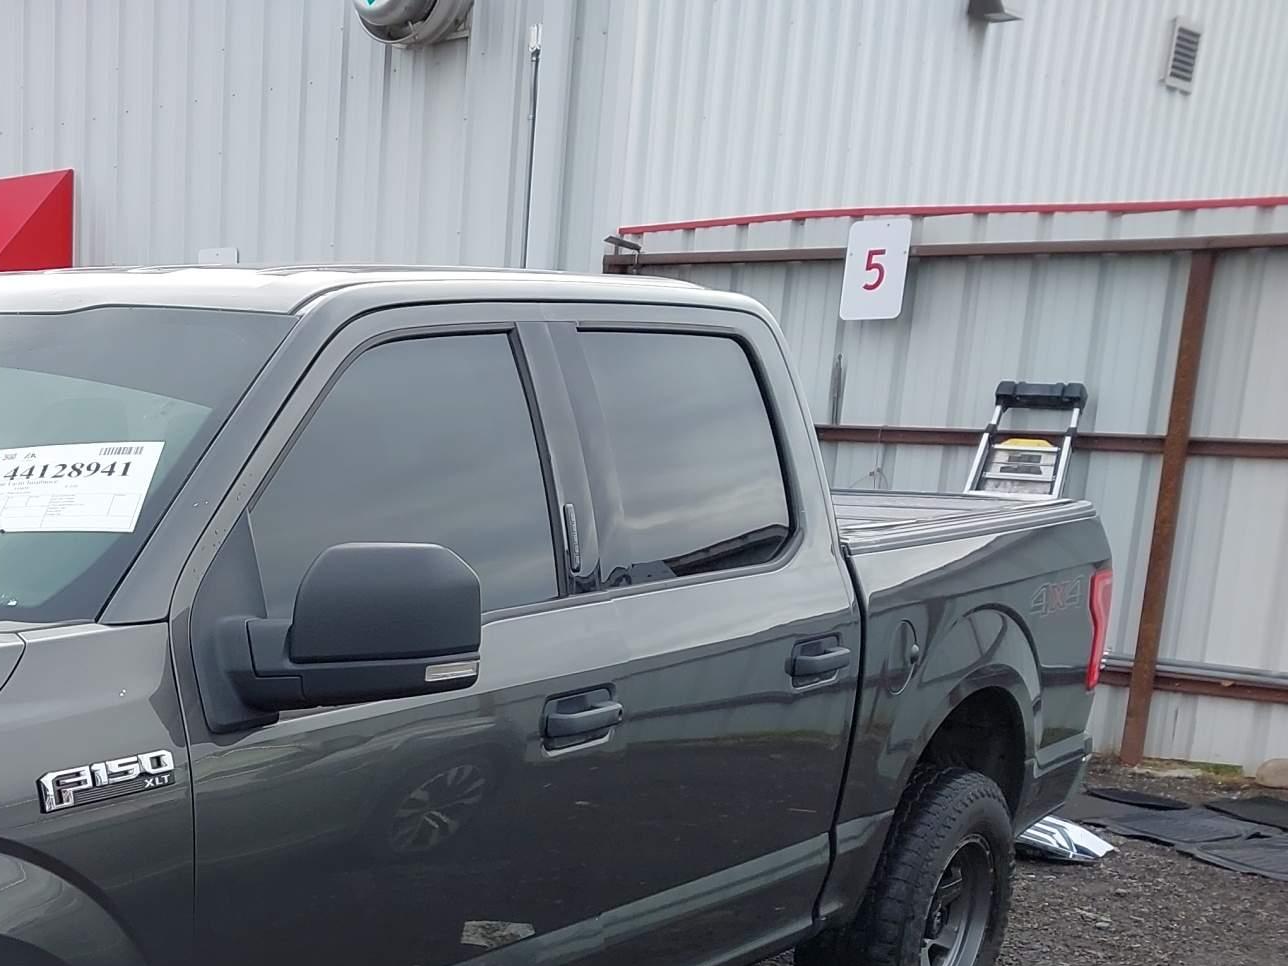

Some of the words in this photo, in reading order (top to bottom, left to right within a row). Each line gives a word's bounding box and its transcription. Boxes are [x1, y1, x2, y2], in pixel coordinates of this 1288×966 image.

[863, 248, 886, 291] 5
[3, 460, 133, 481] 44128941
[144, 774, 171, 789] XLT
